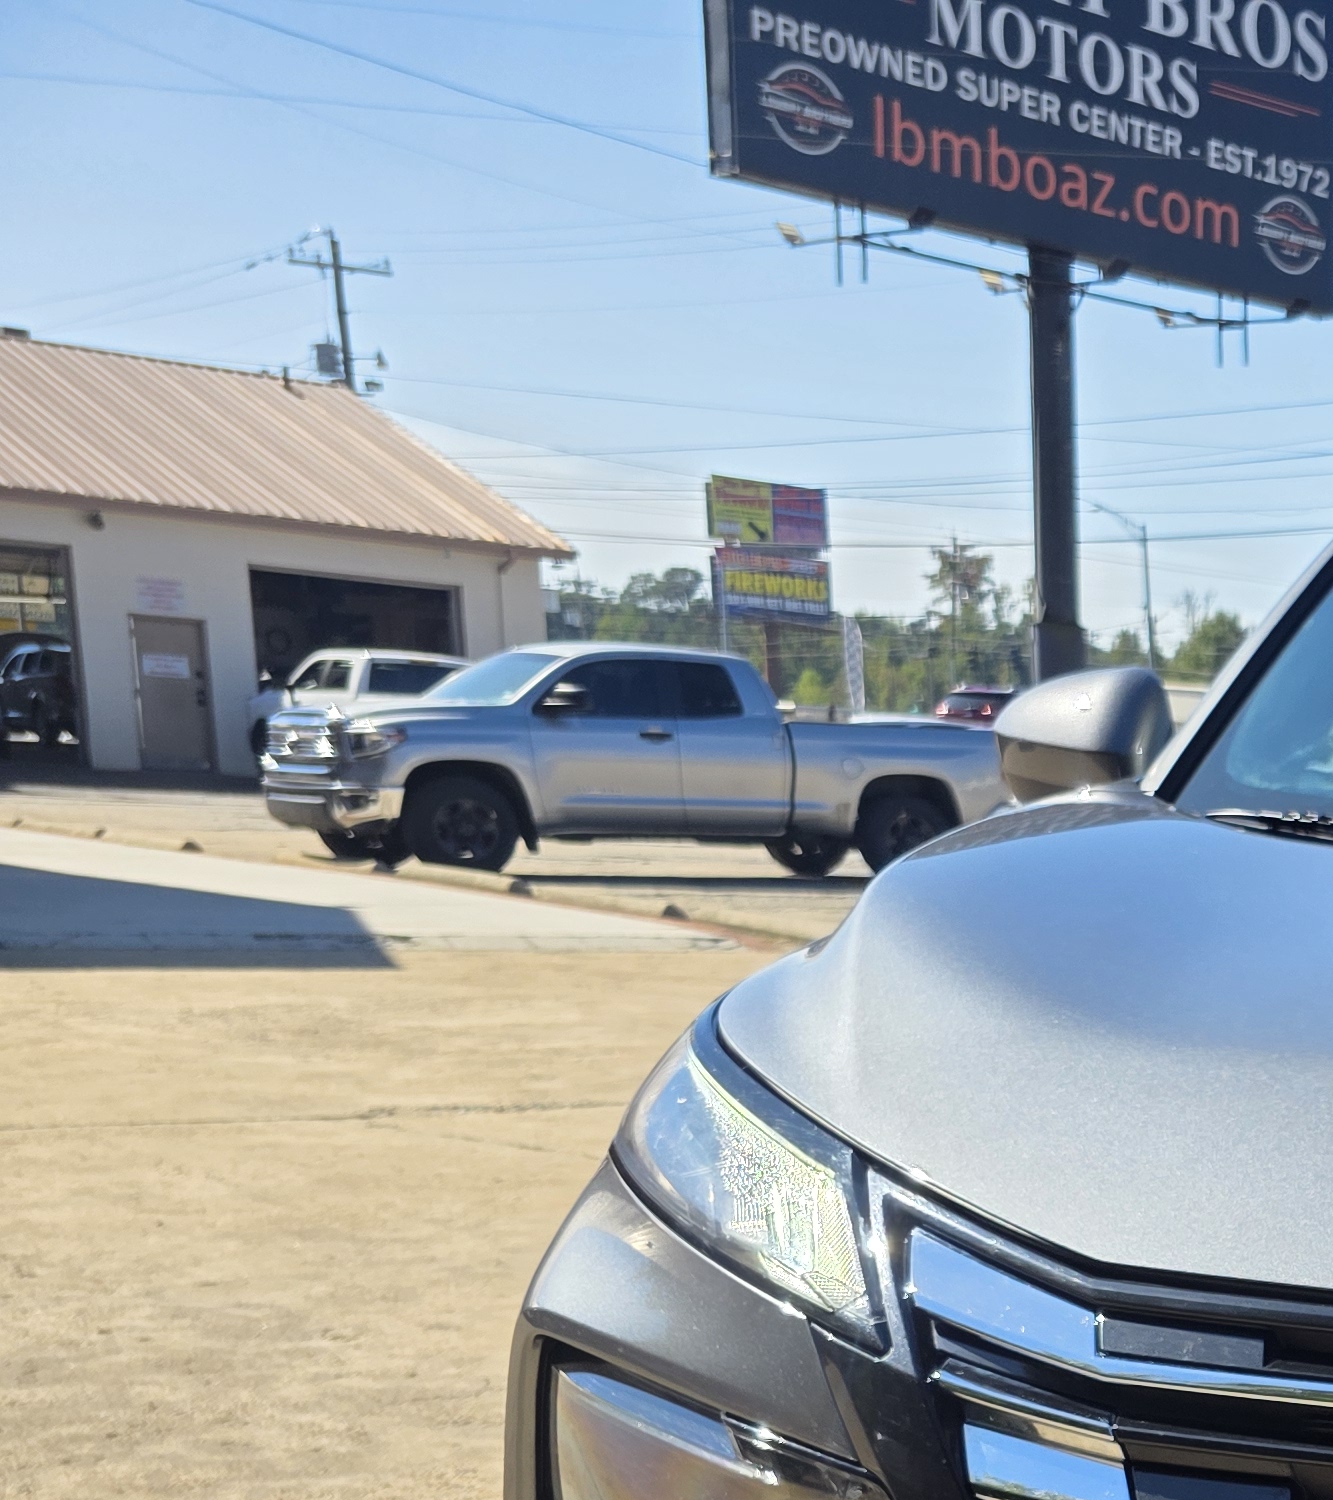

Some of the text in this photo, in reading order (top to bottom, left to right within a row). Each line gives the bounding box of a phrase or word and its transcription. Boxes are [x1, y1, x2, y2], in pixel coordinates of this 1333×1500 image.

[750, 4, 948, 92] PREOWNED
[955, 66, 1062, 127] SUPER
[1068, 99, 1183, 160] CENTER
[1206, 136, 1331, 199] EST.1972
[925, 0, 1200, 119] MOTORS
[873, 92, 1240, 248] lbmboaz.com
